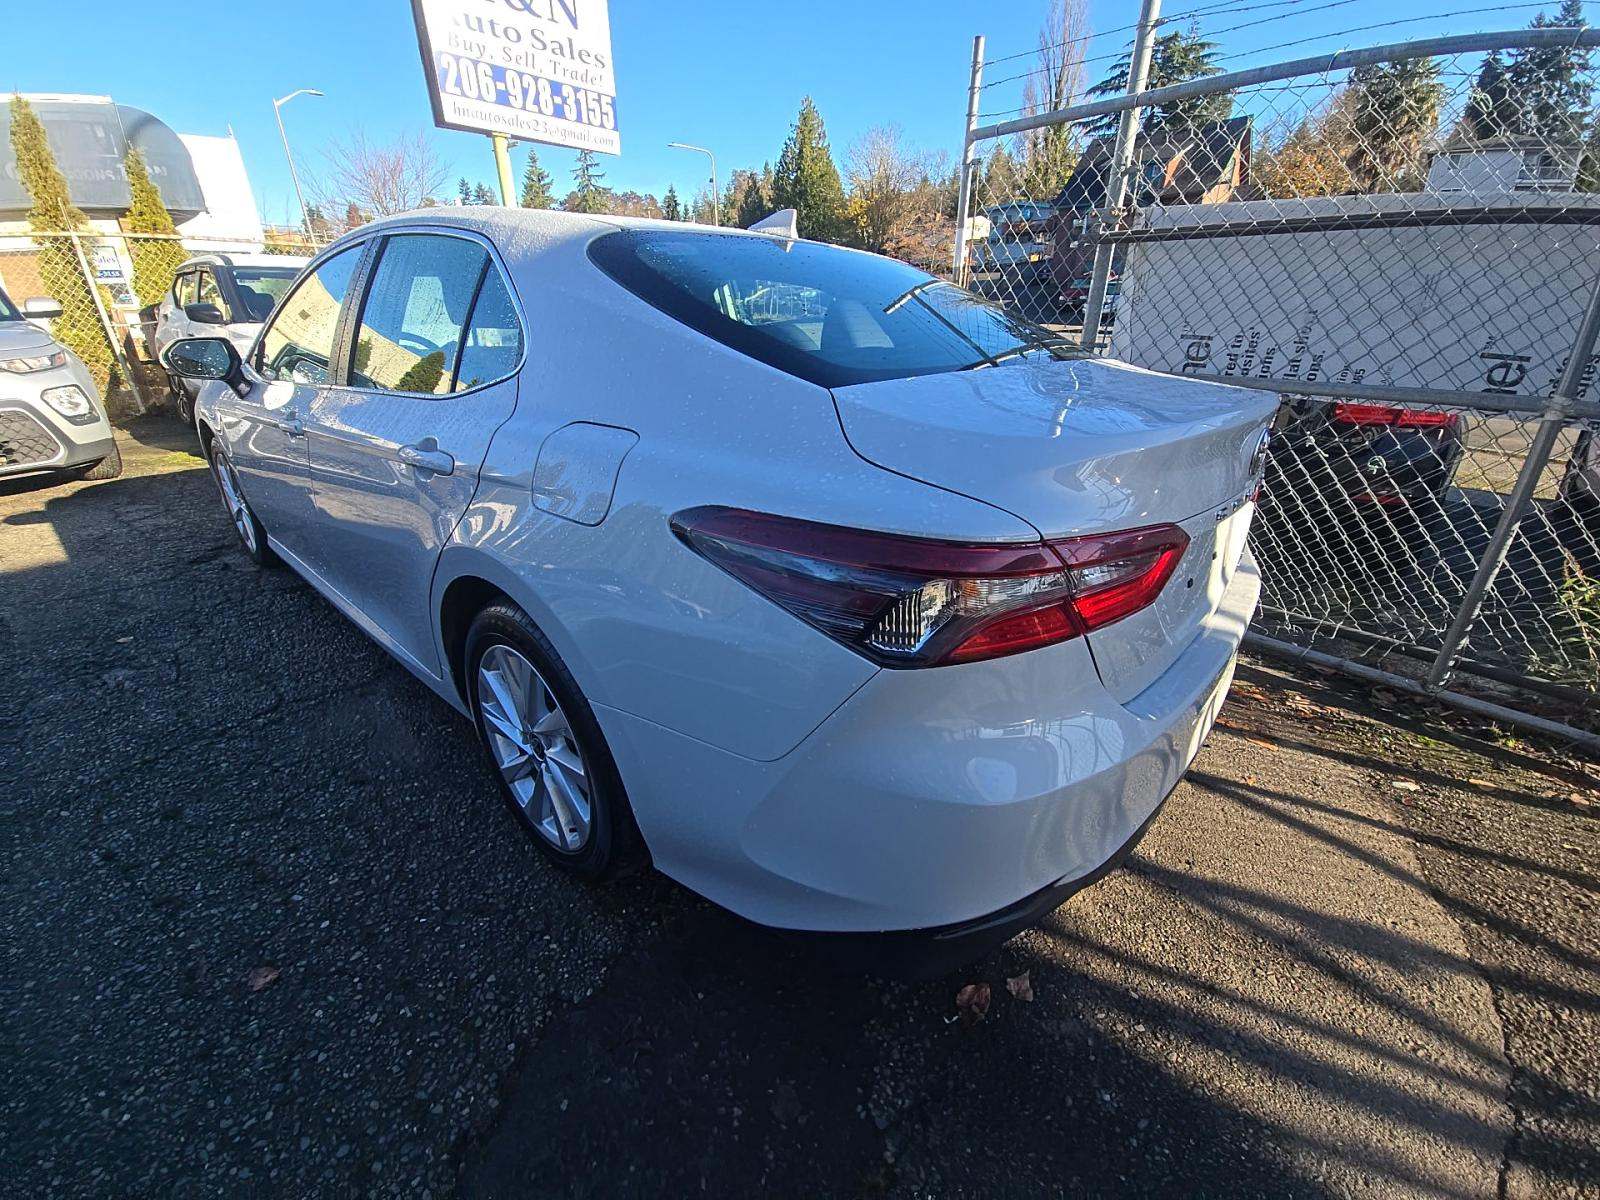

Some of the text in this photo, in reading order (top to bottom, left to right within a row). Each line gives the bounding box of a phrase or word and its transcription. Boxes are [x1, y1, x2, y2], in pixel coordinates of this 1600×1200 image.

[452, 13, 606, 69] uto Sales
[440, 53, 615, 130] 206-928-3155
